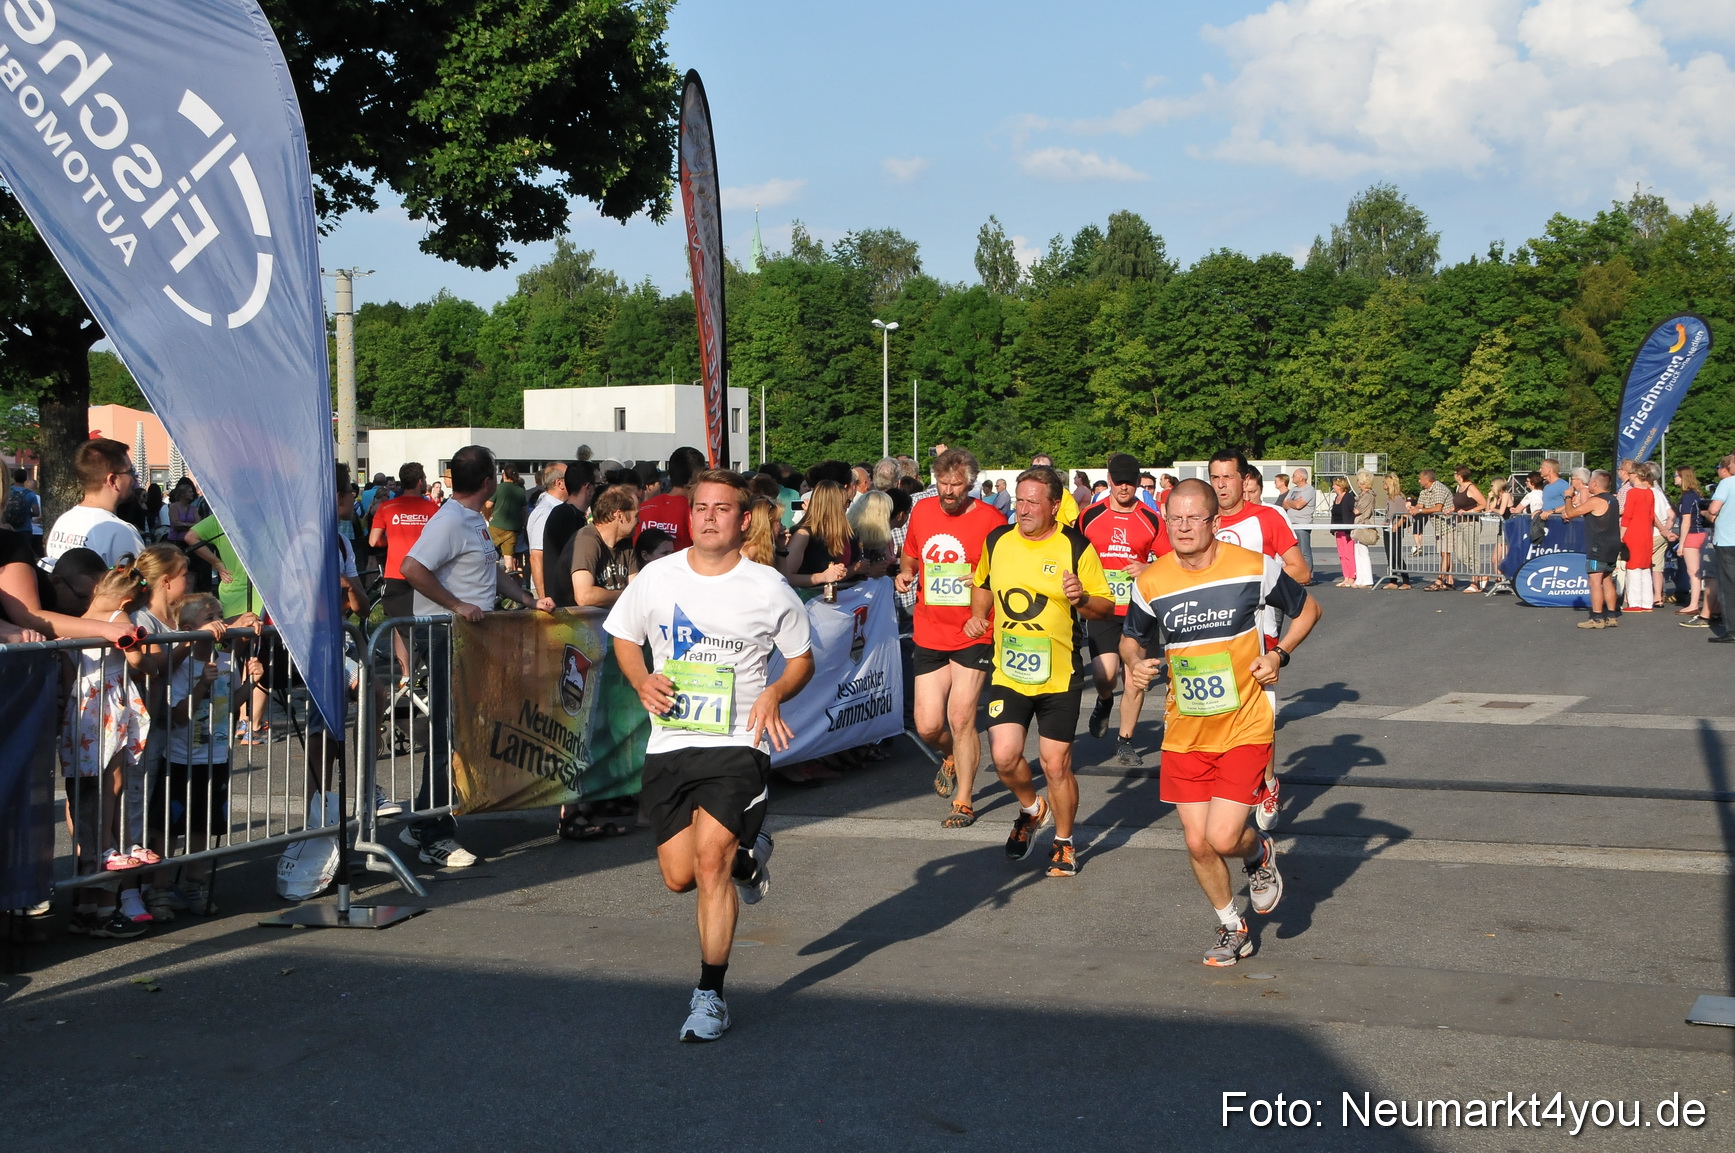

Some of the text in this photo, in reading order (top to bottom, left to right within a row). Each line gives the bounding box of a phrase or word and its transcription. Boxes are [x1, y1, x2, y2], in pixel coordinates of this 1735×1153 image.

[1664, 370, 1681, 392] Druck
[1622, 355, 1684, 439] Frischmann
[400, 513, 429, 522] Petry
[648, 520, 678, 534] Petry
[51, 530, 89, 547] OLGER
[1108, 544, 1132, 553] MEYER
[1043, 564, 1056, 573] FC
[930, 577, 963, 595] 456
[1541, 576, 1588, 589] Fisch
[1174, 608, 1236, 628] Fischer
[1180, 620, 1232, 634] AUTOMOBILE
[682, 649, 717, 662] Team
[1006, 649, 1041, 672] 229
[1181, 675, 1225, 701] 388
[661, 693, 723, 723] 071
[825, 689, 892, 732] Lammsbräu
